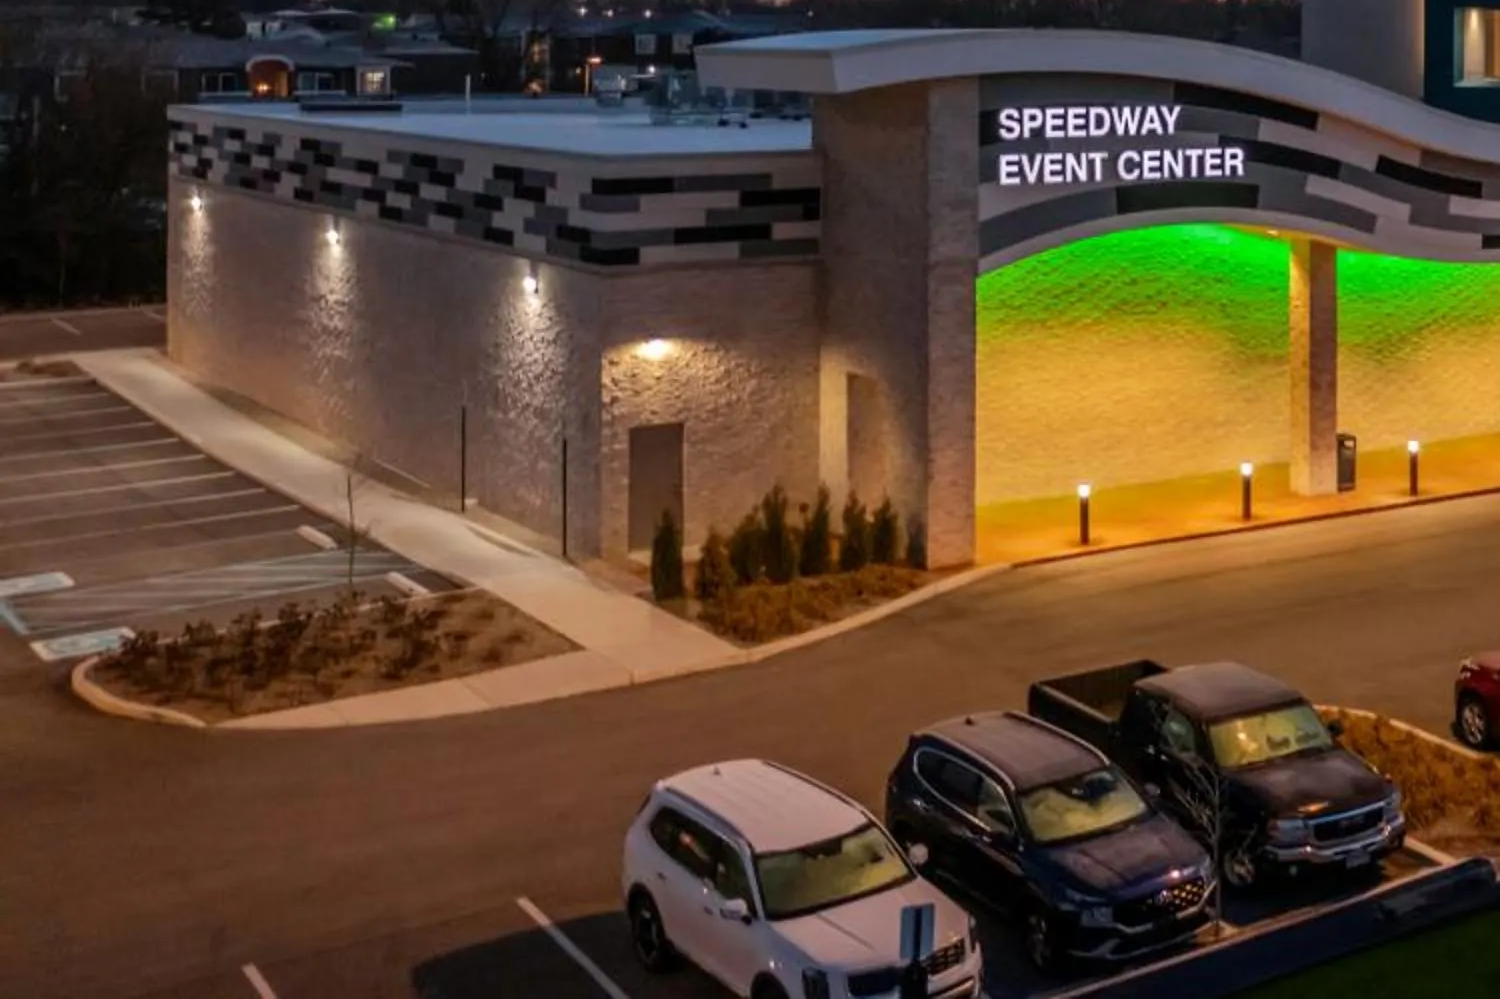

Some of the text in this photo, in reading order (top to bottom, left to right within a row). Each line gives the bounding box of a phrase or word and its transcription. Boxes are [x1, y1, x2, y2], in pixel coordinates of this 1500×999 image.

[998, 105, 1181, 139] SPEEDWAY
[999, 147, 1245, 185] EVENT CENTER
